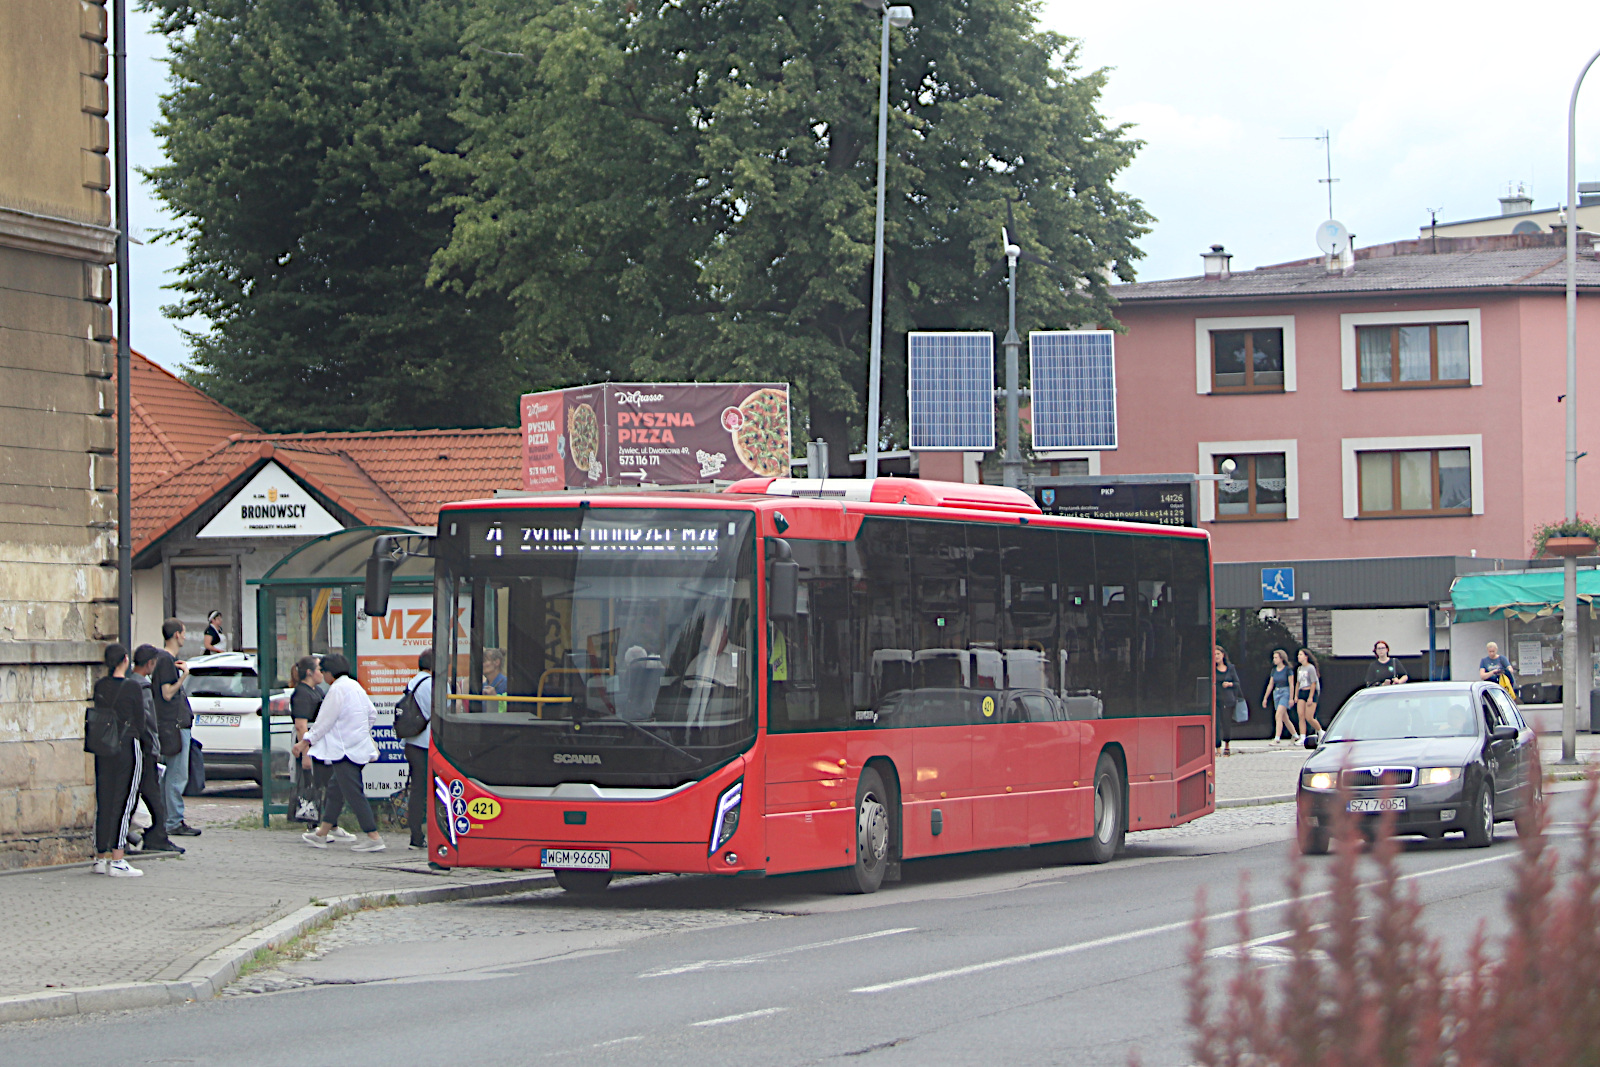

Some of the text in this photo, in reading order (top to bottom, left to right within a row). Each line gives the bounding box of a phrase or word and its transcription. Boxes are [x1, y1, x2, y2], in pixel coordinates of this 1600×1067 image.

[617, 412, 695, 426] PYSZNA
[527, 420, 556, 434] PYSZNA
[528, 433, 549, 445] PIZZA
[618, 428, 675, 444] PIZZA
[648, 446, 681, 454] Dworcowa
[619, 455, 660, 465] 573 116 171
[1161, 494, 1184, 503] 14:26
[241, 504, 306, 518] BRONOWSCY
[1159, 509, 1185, 517] 14:29
[216, 716, 239, 724] 75185
[553, 753, 602, 764] SCANIA
[393, 781, 403, 790] 33
[472, 802, 494, 815] 421
[1351, 799, 1405, 811] SZY 76054
[548, 851, 608, 864] WGM 9665N
